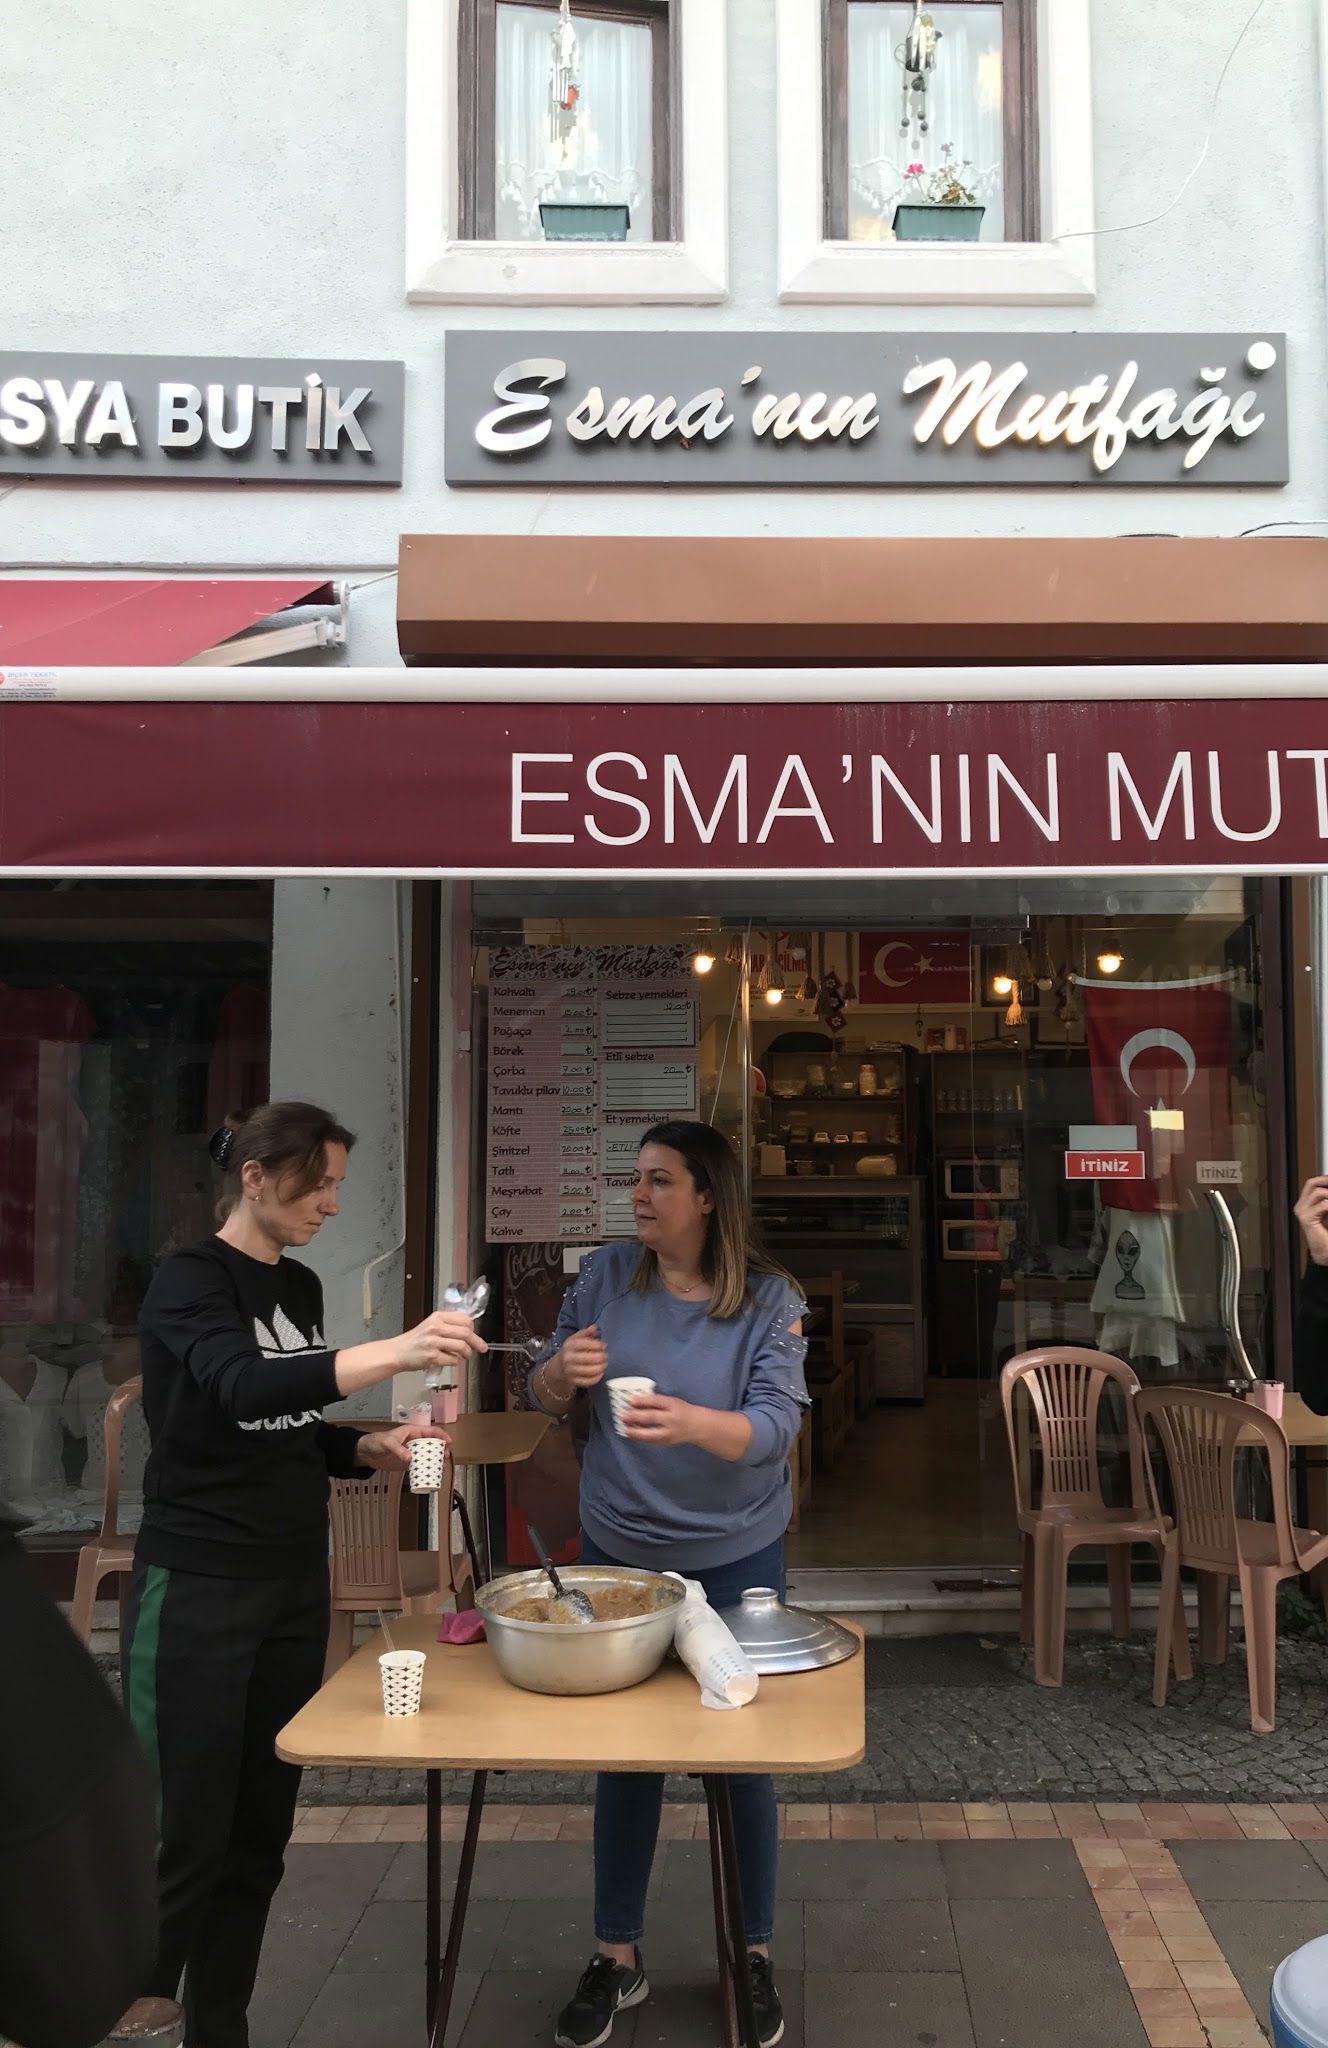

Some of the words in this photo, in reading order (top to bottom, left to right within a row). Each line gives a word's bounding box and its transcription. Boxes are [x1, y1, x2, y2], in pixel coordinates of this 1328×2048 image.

[0, 377, 137, 448] SYA
[158, 373, 373, 453] BUTİK
[511, 752, 1060, 846] ESMA'NIN
[1108, 749, 1328, 843] MUT
[493, 987, 536, 997] Kahvaltı
[605, 990, 636, 999] Sebze
[639, 988, 688, 1000] yemekleri
[493, 1006, 546, 1016] Menemen
[493, 1027, 532, 1038] Poğaça
[493, 1046, 525, 1056] Börek
[605, 1051, 622, 1061] Etli
[624, 1051, 655, 1061] sebze
[493, 1066, 526, 1077] Çorba
[493, 1086, 533, 1095] Tavuklu
[536, 1086, 560, 1097] pilav
[492, 1105, 523, 1115] Mantı
[606, 1114, 616, 1124] Et
[618, 1113, 671, 1126] yemekleri
[492, 1126, 521, 1137] Köfte
[492, 1146, 530, 1157] Şinitzel
[1081, 1158, 1130, 1172] İTİNİZ
[492, 1166, 515, 1176] Tatlı
[1201, 1166, 1238, 1178] İTİNİZ
[491, 1186, 543, 1198] Meşrubat
[491, 1206, 512, 1218] Çay
[491, 1226, 524, 1236] Kahve
